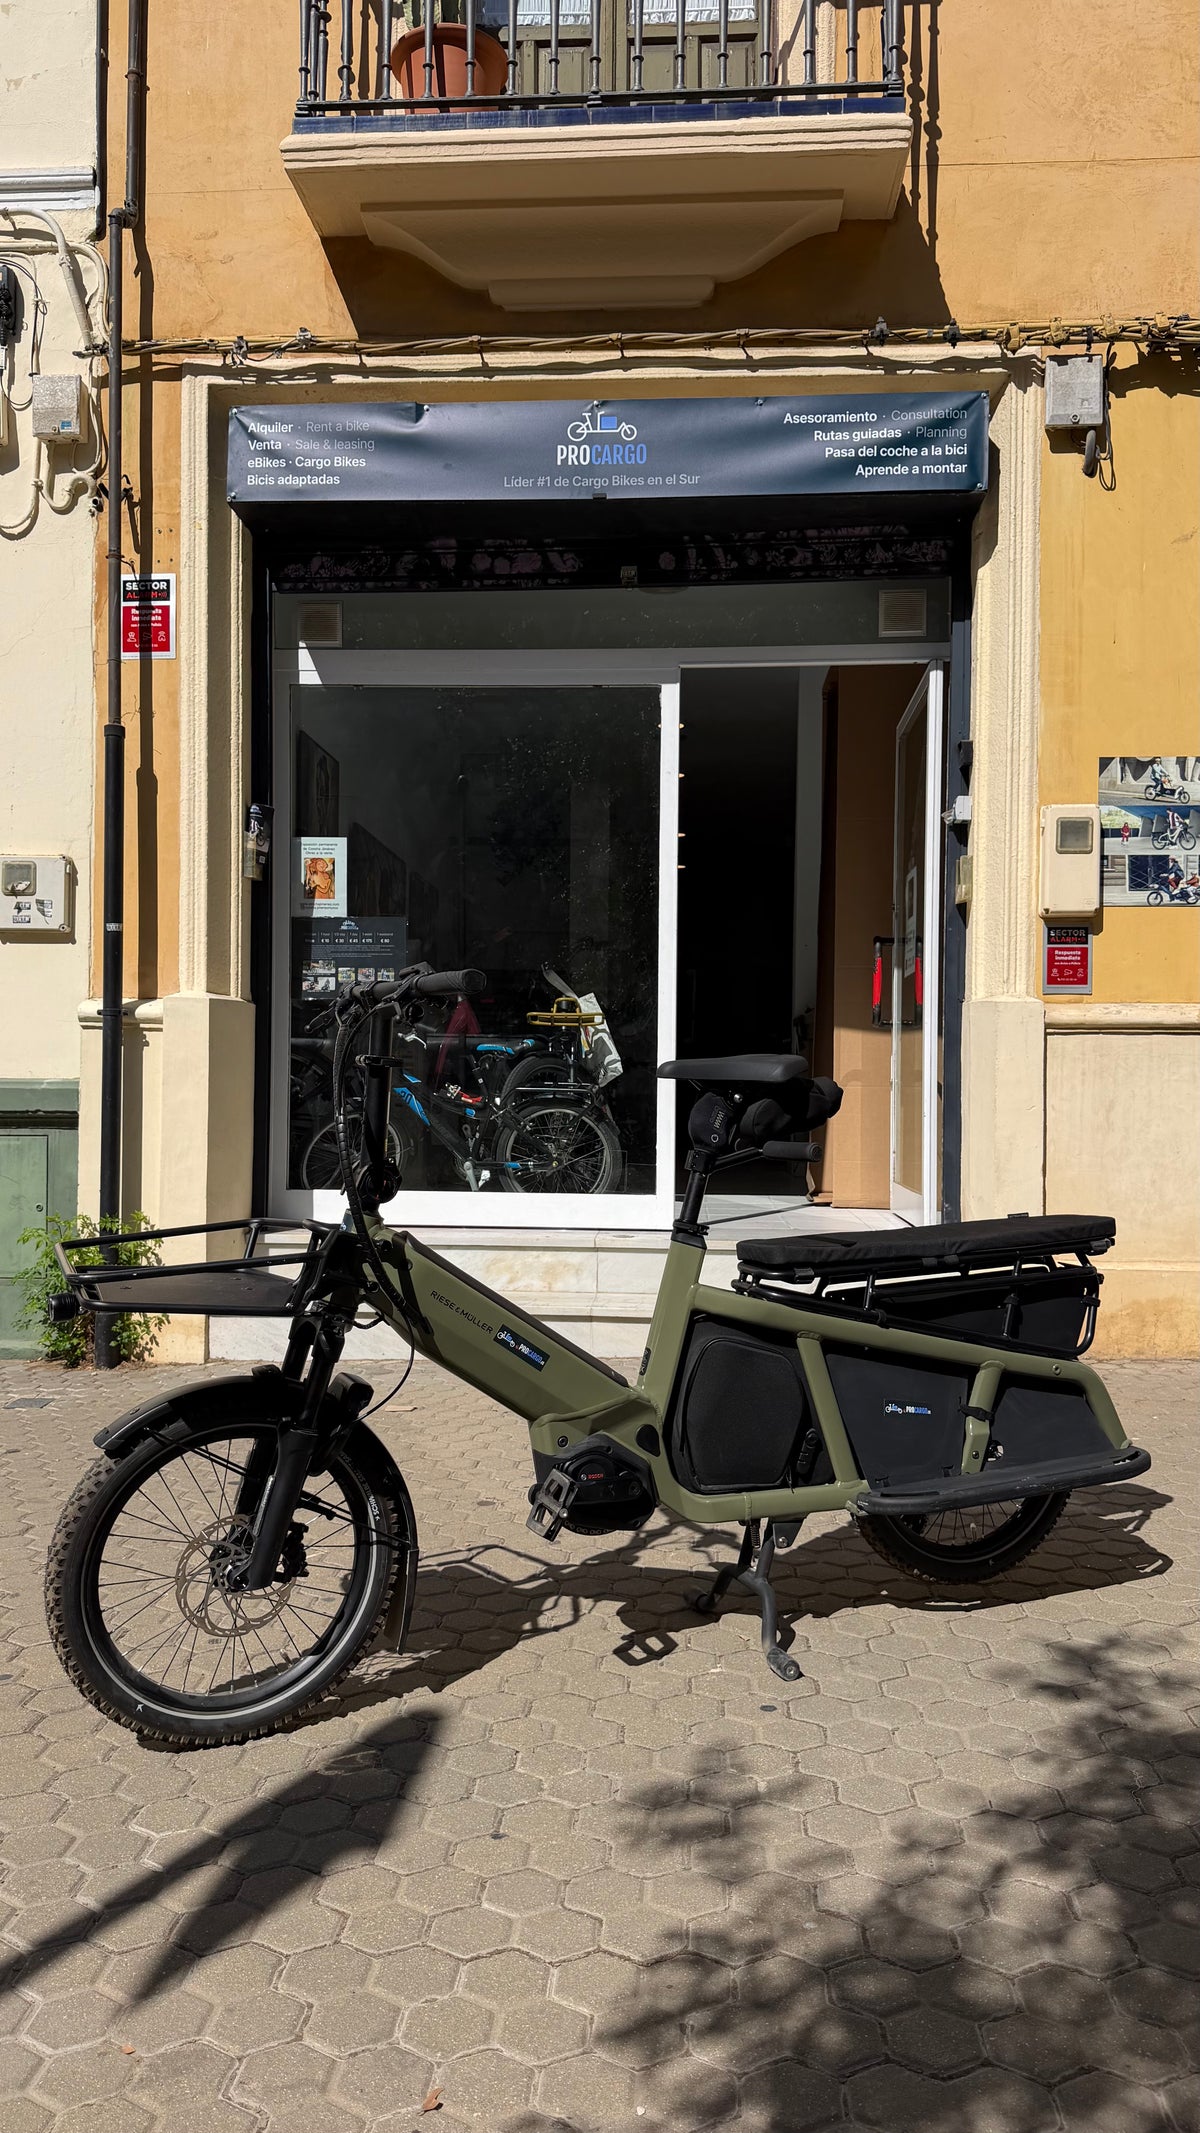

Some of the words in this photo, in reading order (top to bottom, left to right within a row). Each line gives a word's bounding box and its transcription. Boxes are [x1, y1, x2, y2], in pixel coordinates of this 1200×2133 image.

[784, 411, 877, 423] Asesoramiento
[892, 407, 967, 421] Consultation
[248, 421, 294, 434] Alquiler
[307, 421, 332, 432] Rent
[335, 423, 343, 431] a
[346, 420, 370, 431] bike
[815, 431, 849, 441] Rutas
[853, 428, 901, 441] guiadas
[916, 426, 967, 440] Planning
[248, 440, 282, 450] Venta
[295, 439, 319, 449] Sale
[323, 439, 331, 450] &
[334, 438, 375, 452] leasing
[826, 448, 855, 458] Pasa
[858, 446, 877, 456] del
[880, 445, 918, 456] coche
[921, 448, 928, 456] a
[932, 445, 942, 455] la
[946, 444, 967, 455] bici
[557, 444, 646, 465] PROCARGO
[248, 457, 286, 468] eBikes
[295, 457, 331, 469] Cargo
[334, 456, 366, 466] Bikes
[856, 464, 909, 478] Aprende
[912, 466, 919, 474] a
[923, 463, 967, 473] montar
[248, 474, 274, 485] Bicis
[278, 474, 340, 487] adaptadas
[504, 476, 534, 487] Líder
[537, 476, 550, 486] #1
[554, 476, 569, 486] de
[573, 476, 608, 489] Cargo
[612, 475, 644, 486] Bikes
[648, 477, 662, 485] en
[666, 474, 675, 484] el
[679, 474, 700, 484] Sur
[126, 581, 167, 590] SECTOR
[126, 591, 158, 599] ALARM
